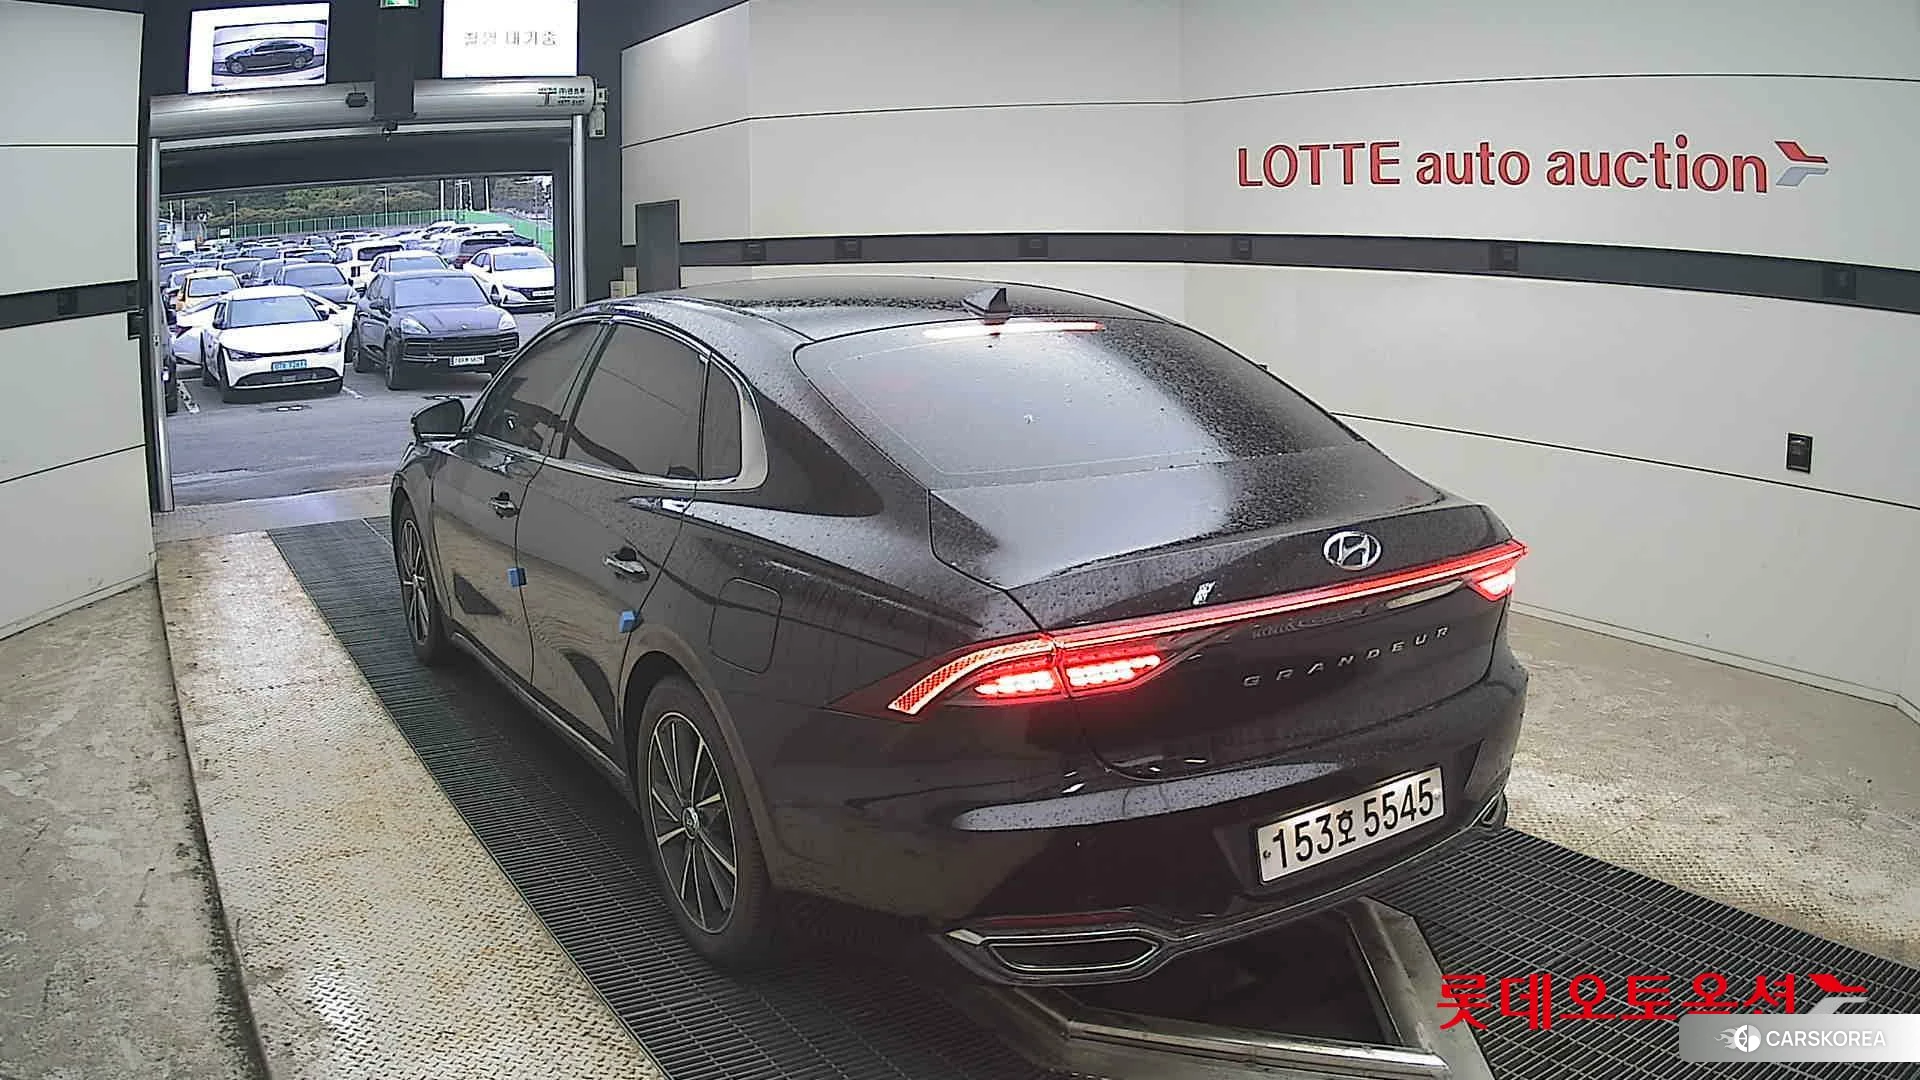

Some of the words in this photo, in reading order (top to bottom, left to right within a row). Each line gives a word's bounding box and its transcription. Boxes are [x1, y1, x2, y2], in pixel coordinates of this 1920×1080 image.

[1238, 141, 1400, 188] LOTTE
[1416, 142, 1530, 186] auto
[1546, 134, 1767, 193] auction
[1243, 625, 1448, 688] GRANDEUR
[1272, 808, 1356, 869] 153호
[1363, 777, 1434, 838] 5545
